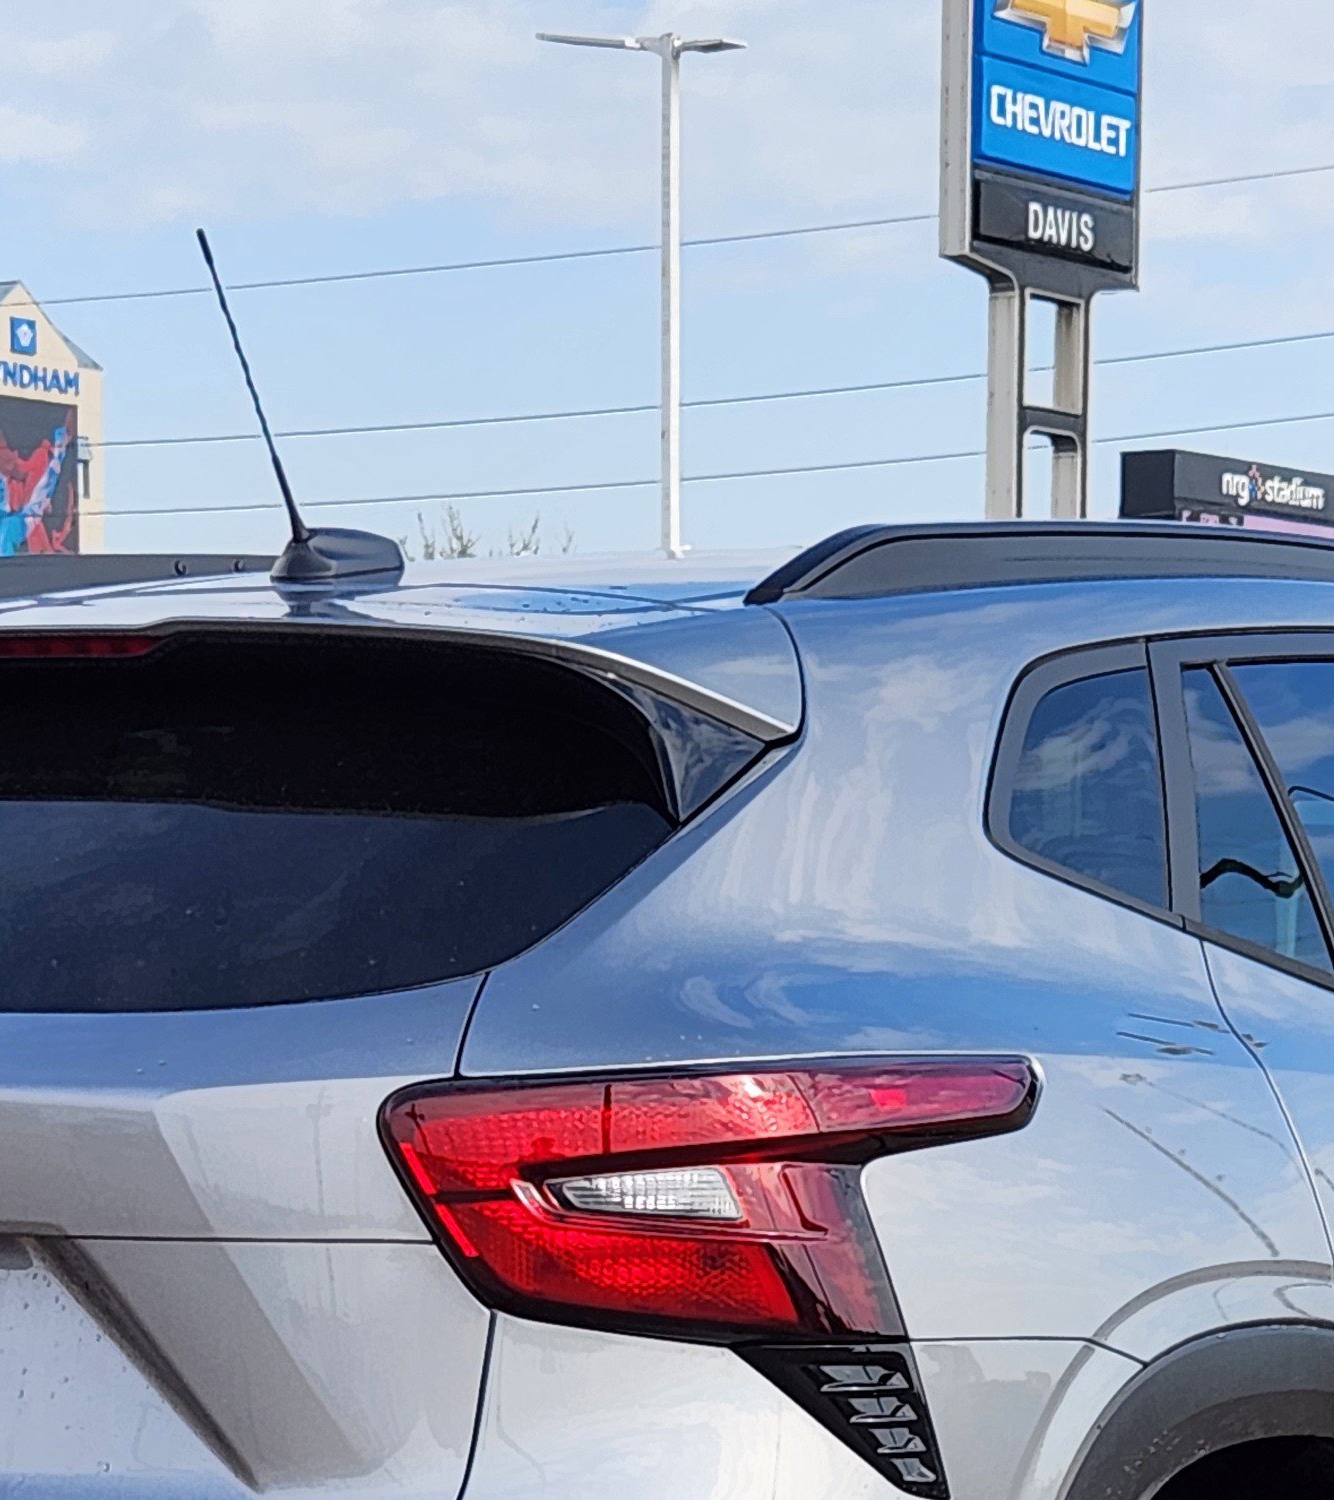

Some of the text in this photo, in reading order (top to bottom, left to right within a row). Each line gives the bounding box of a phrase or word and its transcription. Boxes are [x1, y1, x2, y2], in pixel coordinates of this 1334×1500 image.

[989, 84, 1132, 158] CHEVROLET
[1027, 201, 1095, 252] DAVIS
[1221, 472, 1326, 511] nrg stadium
